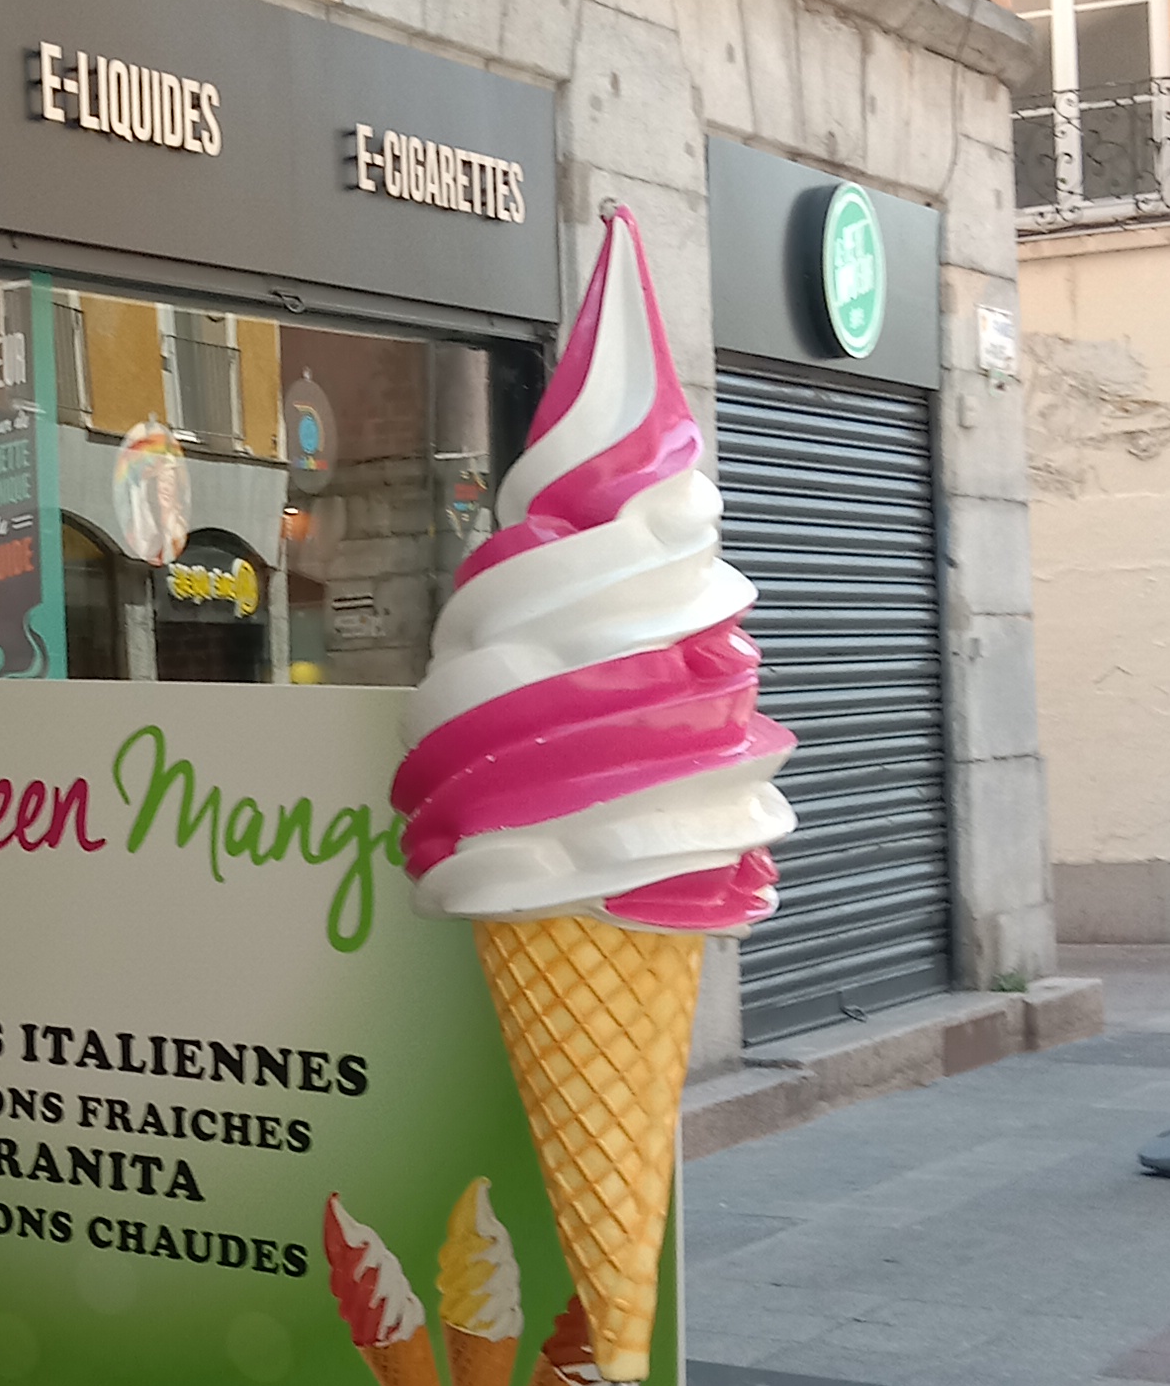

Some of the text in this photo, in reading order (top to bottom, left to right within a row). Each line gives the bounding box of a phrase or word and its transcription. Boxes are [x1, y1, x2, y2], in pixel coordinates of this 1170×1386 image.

[39, 41, 223, 157] E-LIQUIDES
[355, 122, 526, 224] E-CIGARETTES
[20, 1023, 369, 1097] ITALIENNES
[78, 1095, 312, 1154] FRAICHES
[88, 1216, 308, 1278] CHAUDES
